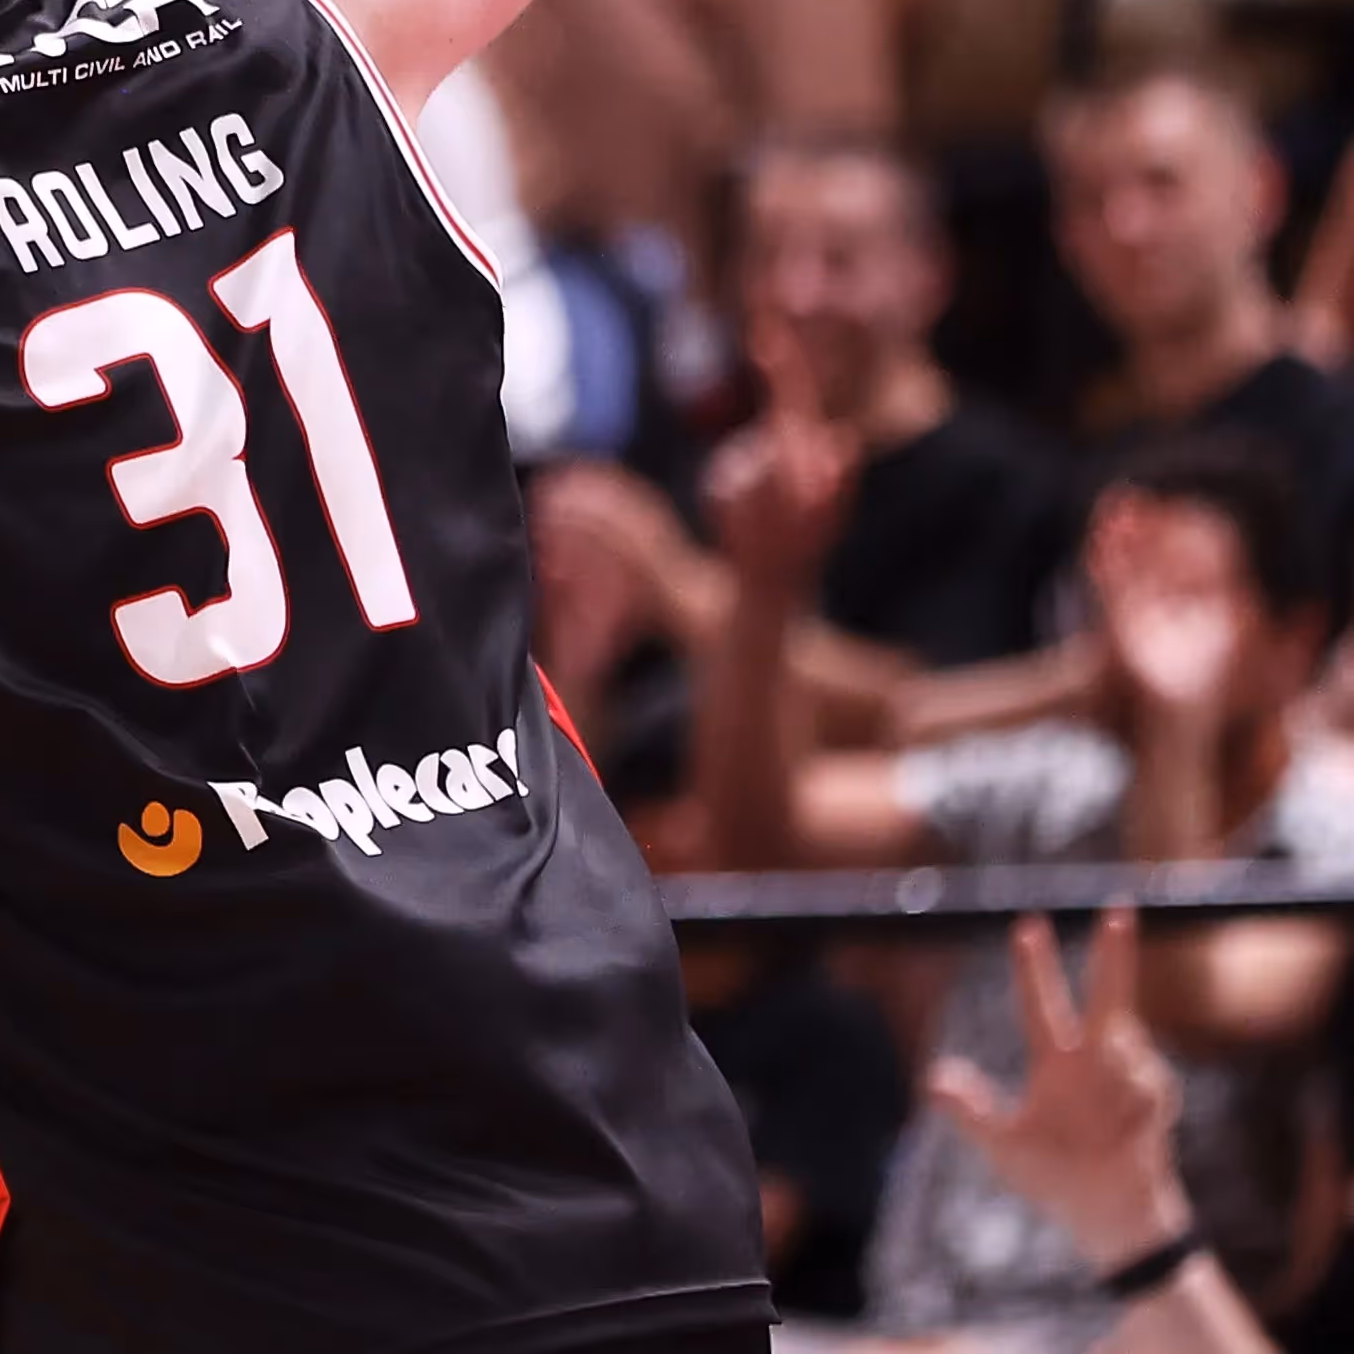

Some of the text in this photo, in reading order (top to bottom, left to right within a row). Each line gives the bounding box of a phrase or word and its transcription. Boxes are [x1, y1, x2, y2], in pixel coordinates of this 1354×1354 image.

[74, 56, 126, 81] CIVIL
[132, 39, 182, 69] AND
[185, 17, 244, 50] RAIL
[18, 226, 420, 689] 31
